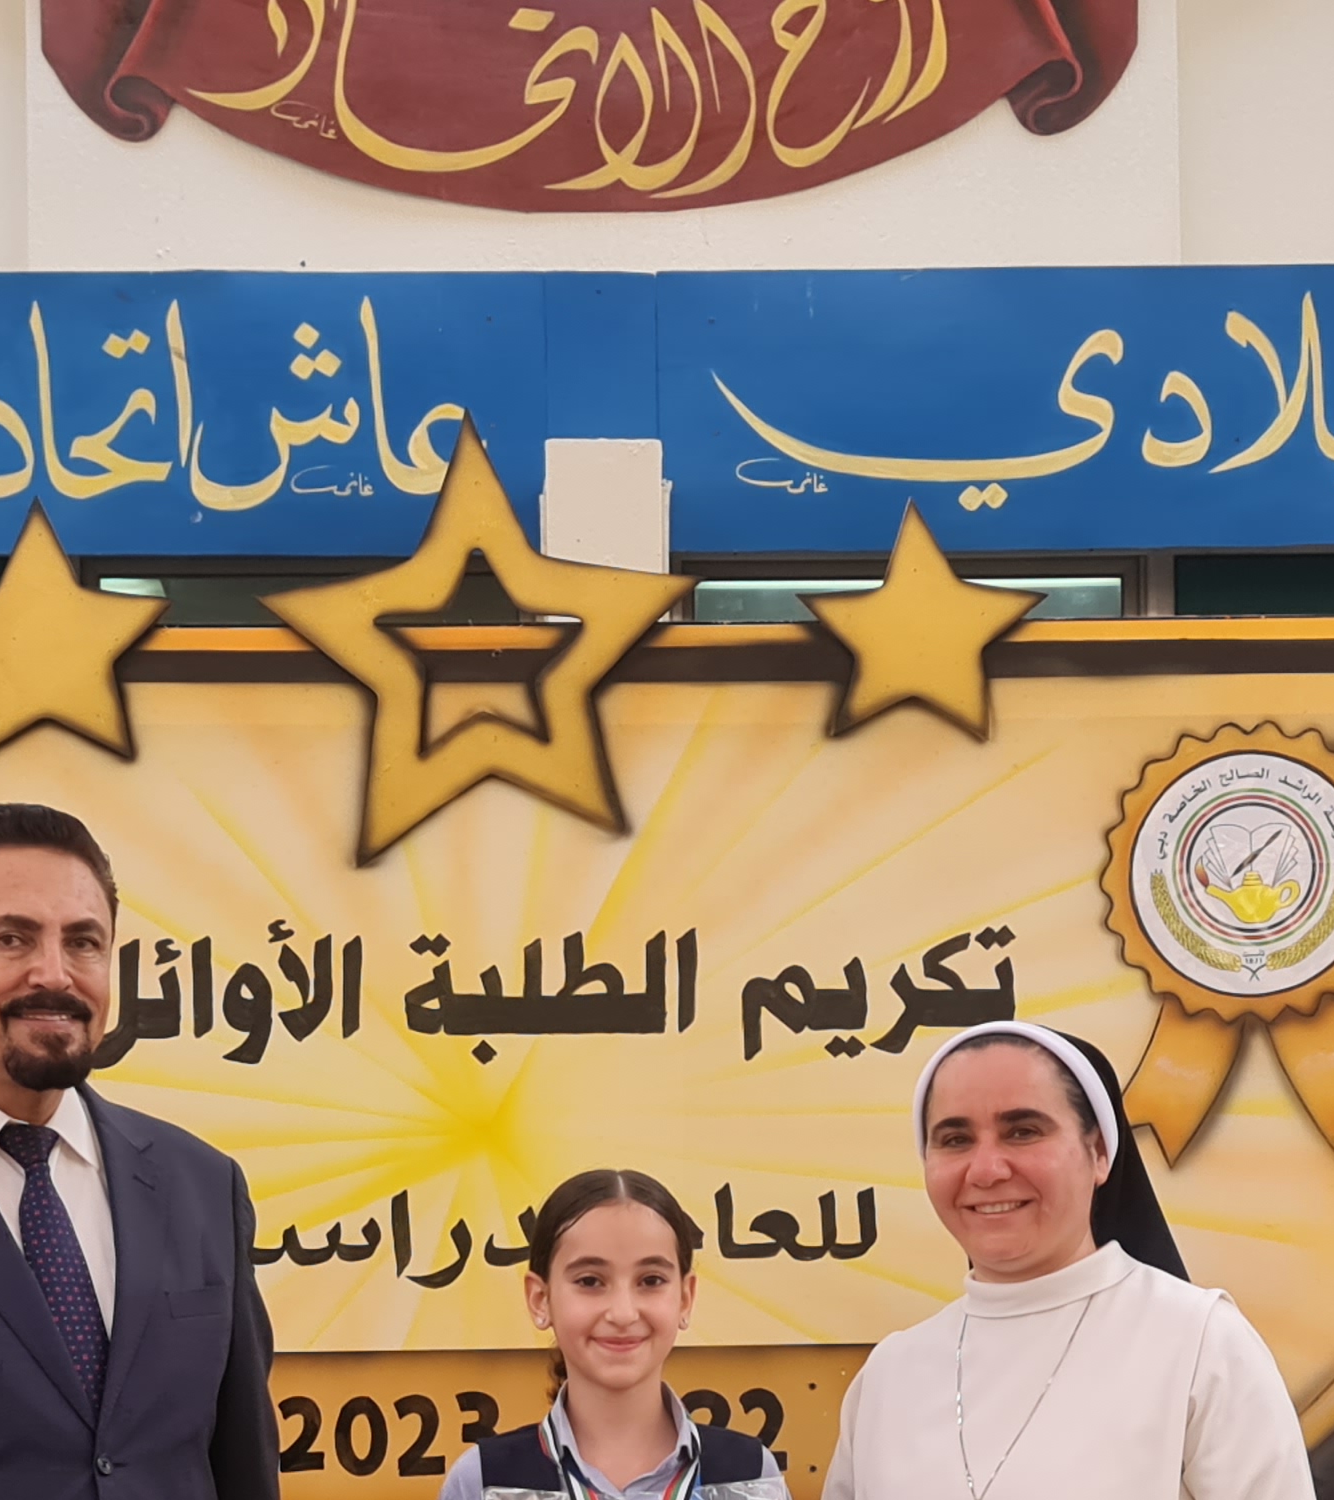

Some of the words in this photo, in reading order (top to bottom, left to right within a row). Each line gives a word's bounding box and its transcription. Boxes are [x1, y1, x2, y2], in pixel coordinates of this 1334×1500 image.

[1163, 778, 1213, 825] الخاصة
[1218, 766, 1270, 787] الصالح
[91, 918, 364, 1066] الأوائل
[404, 926, 698, 1066] الطلبة
[741, 925, 1017, 1061] تكريم
[687, 1181, 881, 1262] للعا
